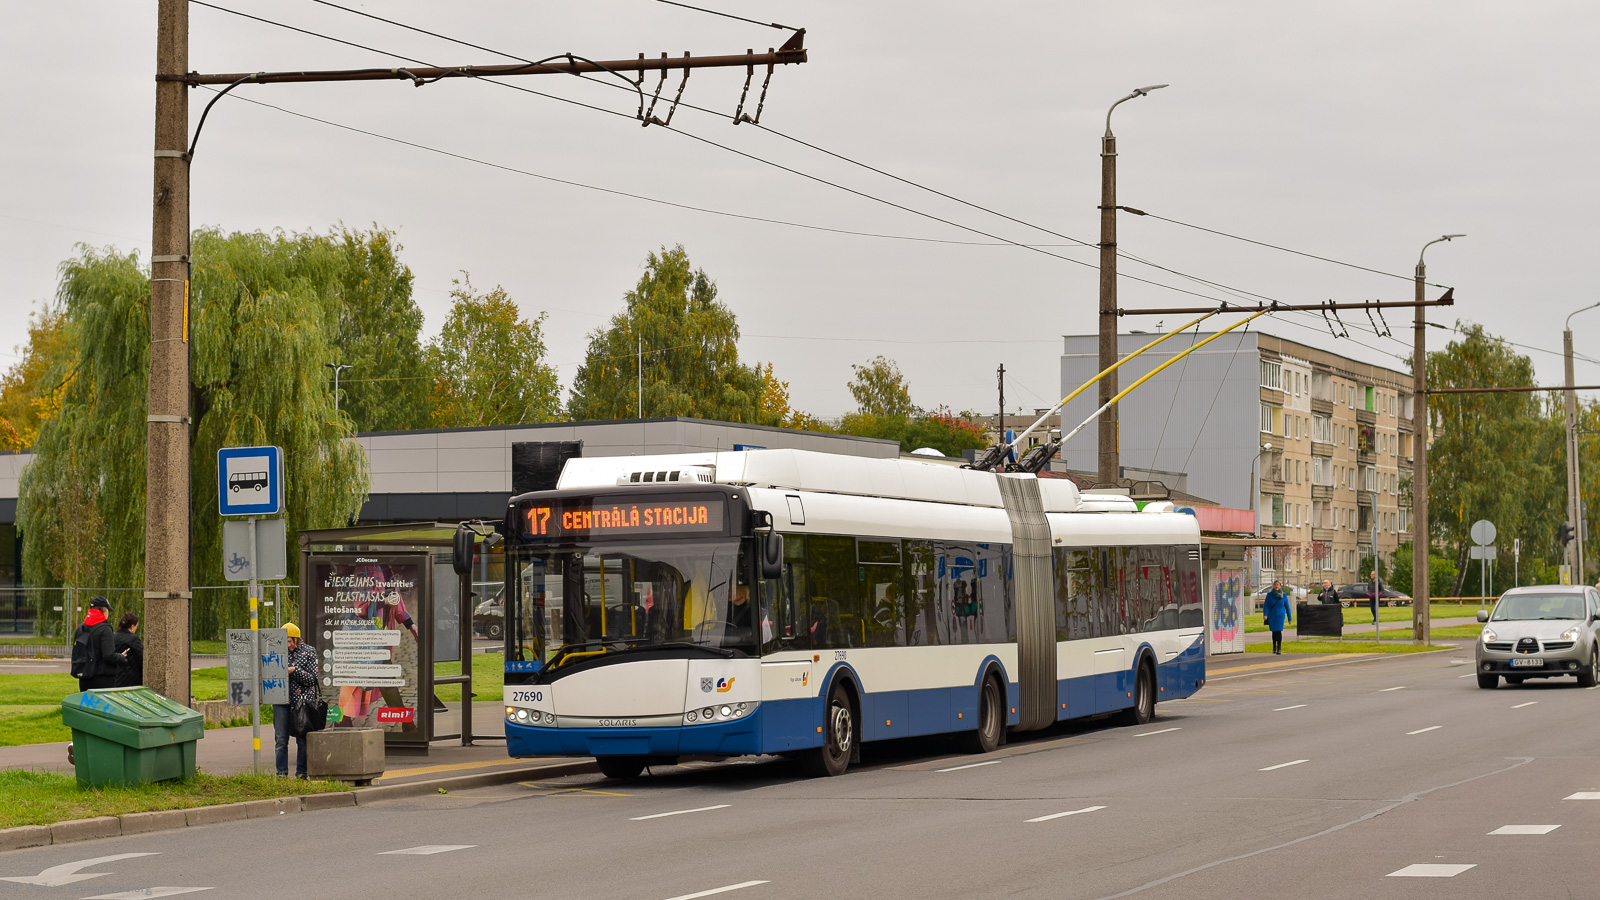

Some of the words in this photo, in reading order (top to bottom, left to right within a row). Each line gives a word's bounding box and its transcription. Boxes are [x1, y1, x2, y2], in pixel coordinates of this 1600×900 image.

[527, 507, 550, 535] 17
[562, 506, 640, 530] CENTRĀLĀ
[644, 506, 708, 526] STACIJA
[324, 580, 330, 588] Ir
[332, 574, 374, 588] IESPĒJAMS
[336, 591, 385, 602] PLASTMASAS
[324, 606, 362, 614] lietošanas
[512, 691, 543, 702] 27690
